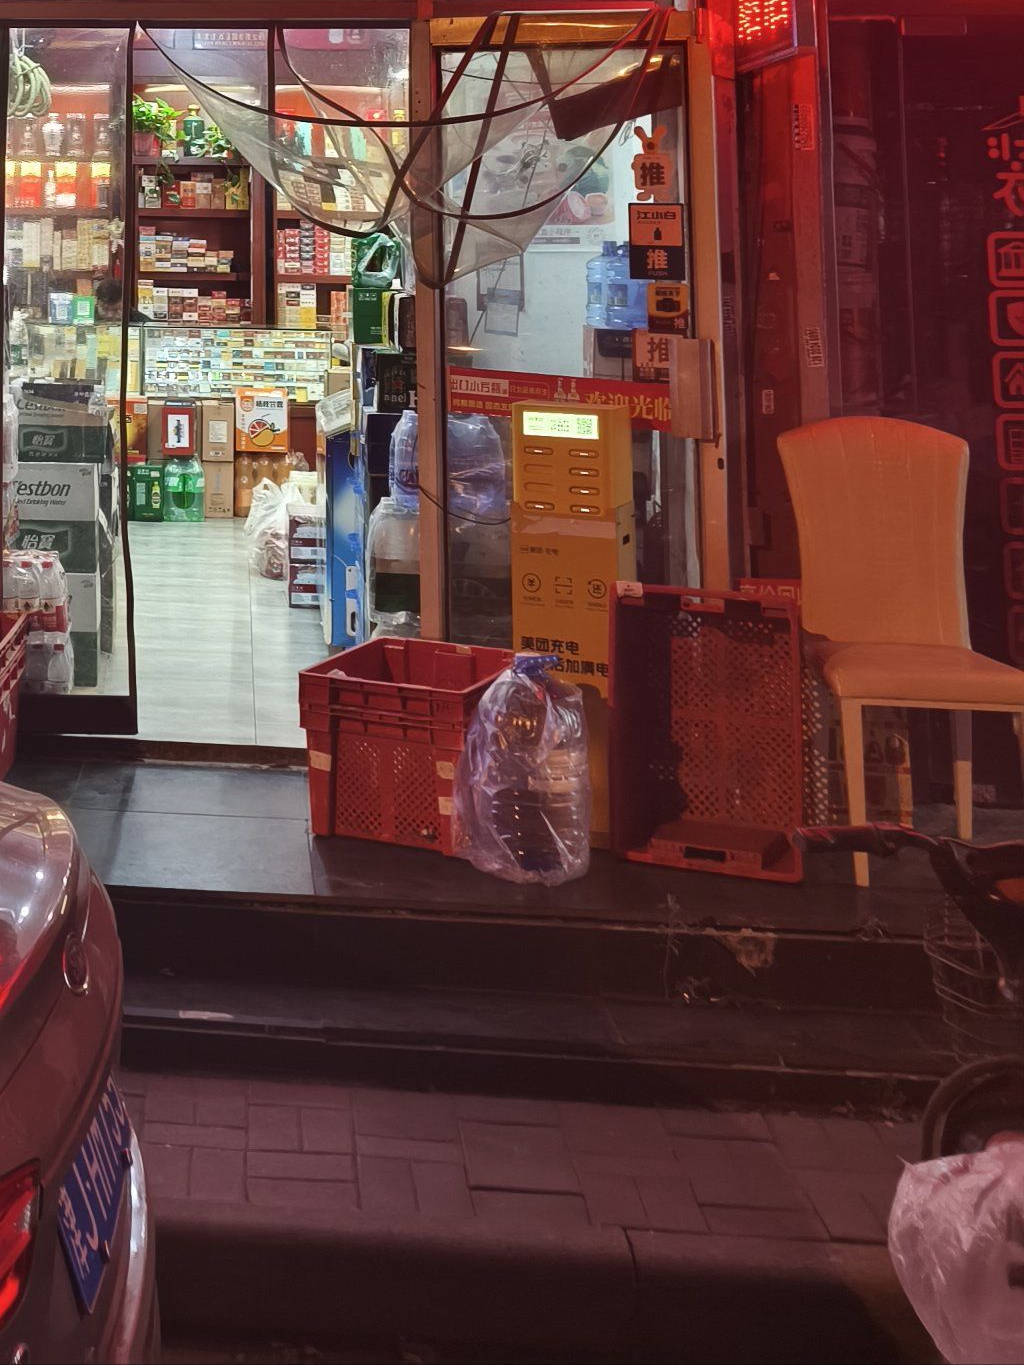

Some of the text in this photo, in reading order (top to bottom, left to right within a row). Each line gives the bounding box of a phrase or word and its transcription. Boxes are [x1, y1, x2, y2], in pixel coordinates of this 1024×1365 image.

[640, 162, 666, 186] 推
[636, 210, 676, 220] 江小白
[646, 249, 668, 269] 推
[584, 391, 672, 422] 欢迎光临
[520, 636, 580, 655] 美团充电
